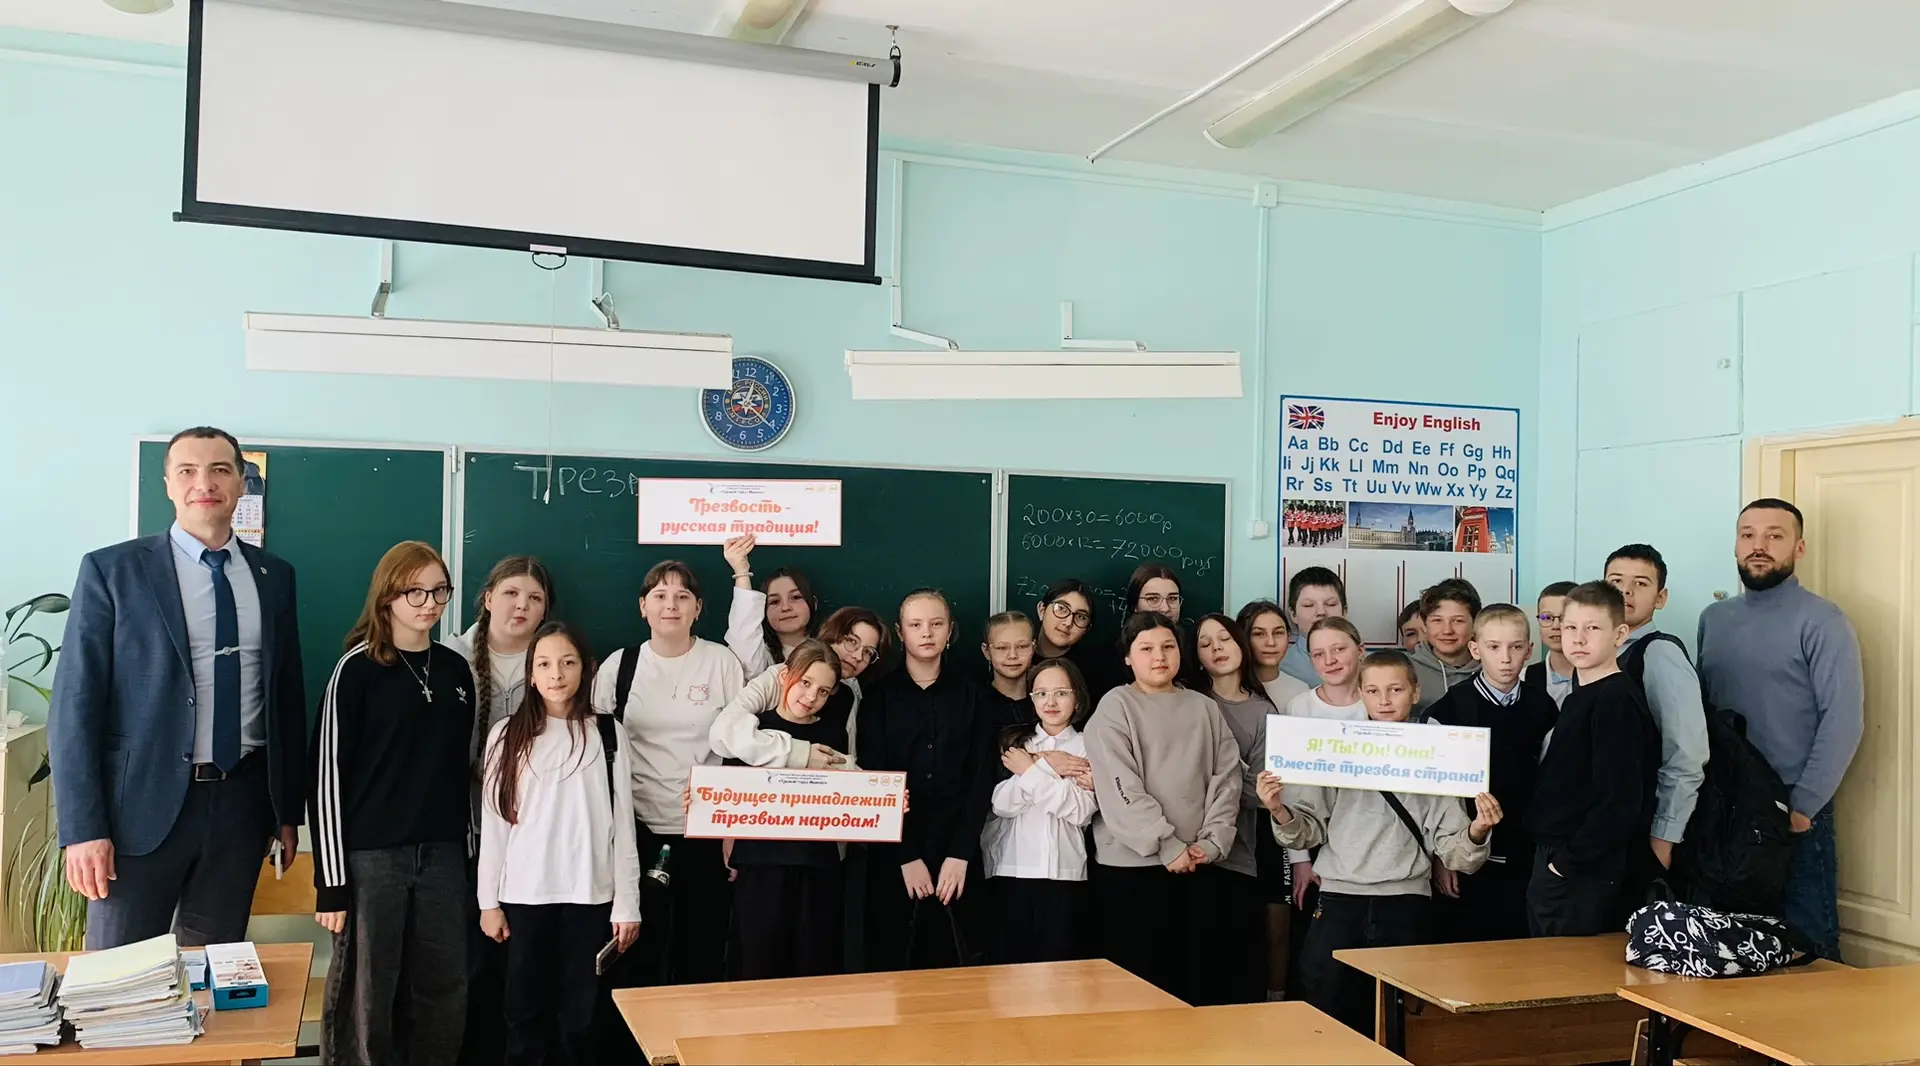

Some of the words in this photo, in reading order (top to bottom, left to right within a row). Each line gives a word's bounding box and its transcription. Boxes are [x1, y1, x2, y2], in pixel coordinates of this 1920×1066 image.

[745, 368, 756, 377] 12
[713, 395, 719, 403] 9
[773, 387, 779, 396] 2
[715, 412, 722, 421] 8
[776, 404, 782, 413] 3
[726, 424, 732, 433] 7
[1373, 412, 1417, 430] Enjoy
[1423, 415, 1480, 432] English
[740, 431, 746, 439] 6
[757, 429, 763, 438] 5
[1288, 436, 1308, 450] Aa
[1319, 437, 1339, 451] Bb
[1349, 438, 1368, 452] Cc
[1383, 440, 1402, 454] Dd
[1413, 442, 1430, 455] Ee
[1440, 443, 1454, 456] Ff
[1463, 444, 1483, 461] Gg
[1493, 446, 1511, 459] Hh
[1283, 456, 1291, 469] Ii
[1301, 457, 1314, 473] Jj
[1320, 458, 1340, 471] Kk
[1350, 459, 1362, 472] Ll
[1373, 460, 1398, 474] Mm
[1409, 462, 1428, 475] Nn
[1438, 463, 1458, 476] Oo
[1468, 465, 1486, 481] Pp
[1496, 466, 1515, 482] Qq
[1286, 477, 1304, 490] Rr
[1314, 478, 1332, 492] Ss
[1343, 479, 1357, 492] Tt
[1367, 480, 1386, 494] Uu
[1392, 481, 1410, 494] Vv
[1416, 482, 1441, 496] Ww
[1447, 483, 1464, 497] Xx
[1469, 484, 1487, 501] Yy
[1496, 486, 1512, 499] Zz
[689, 498, 781, 515] Трезвость
[661, 521, 726, 535] русская
[731, 520, 819, 537] традиция!
[1307, 739, 1323, 752] Я!
[1328, 739, 1357, 754] Ты!
[1395, 744, 1435, 760] Она!
[1270, 755, 1335, 772] Вместе
[1340, 760, 1410, 777] трезвая
[1414, 766, 1484, 783] страна!
[697, 787, 776, 807] Будущее
[781, 792, 896, 807] принадлежит
[711, 809, 794, 826] трезвым
[799, 813, 880, 830] народам!
